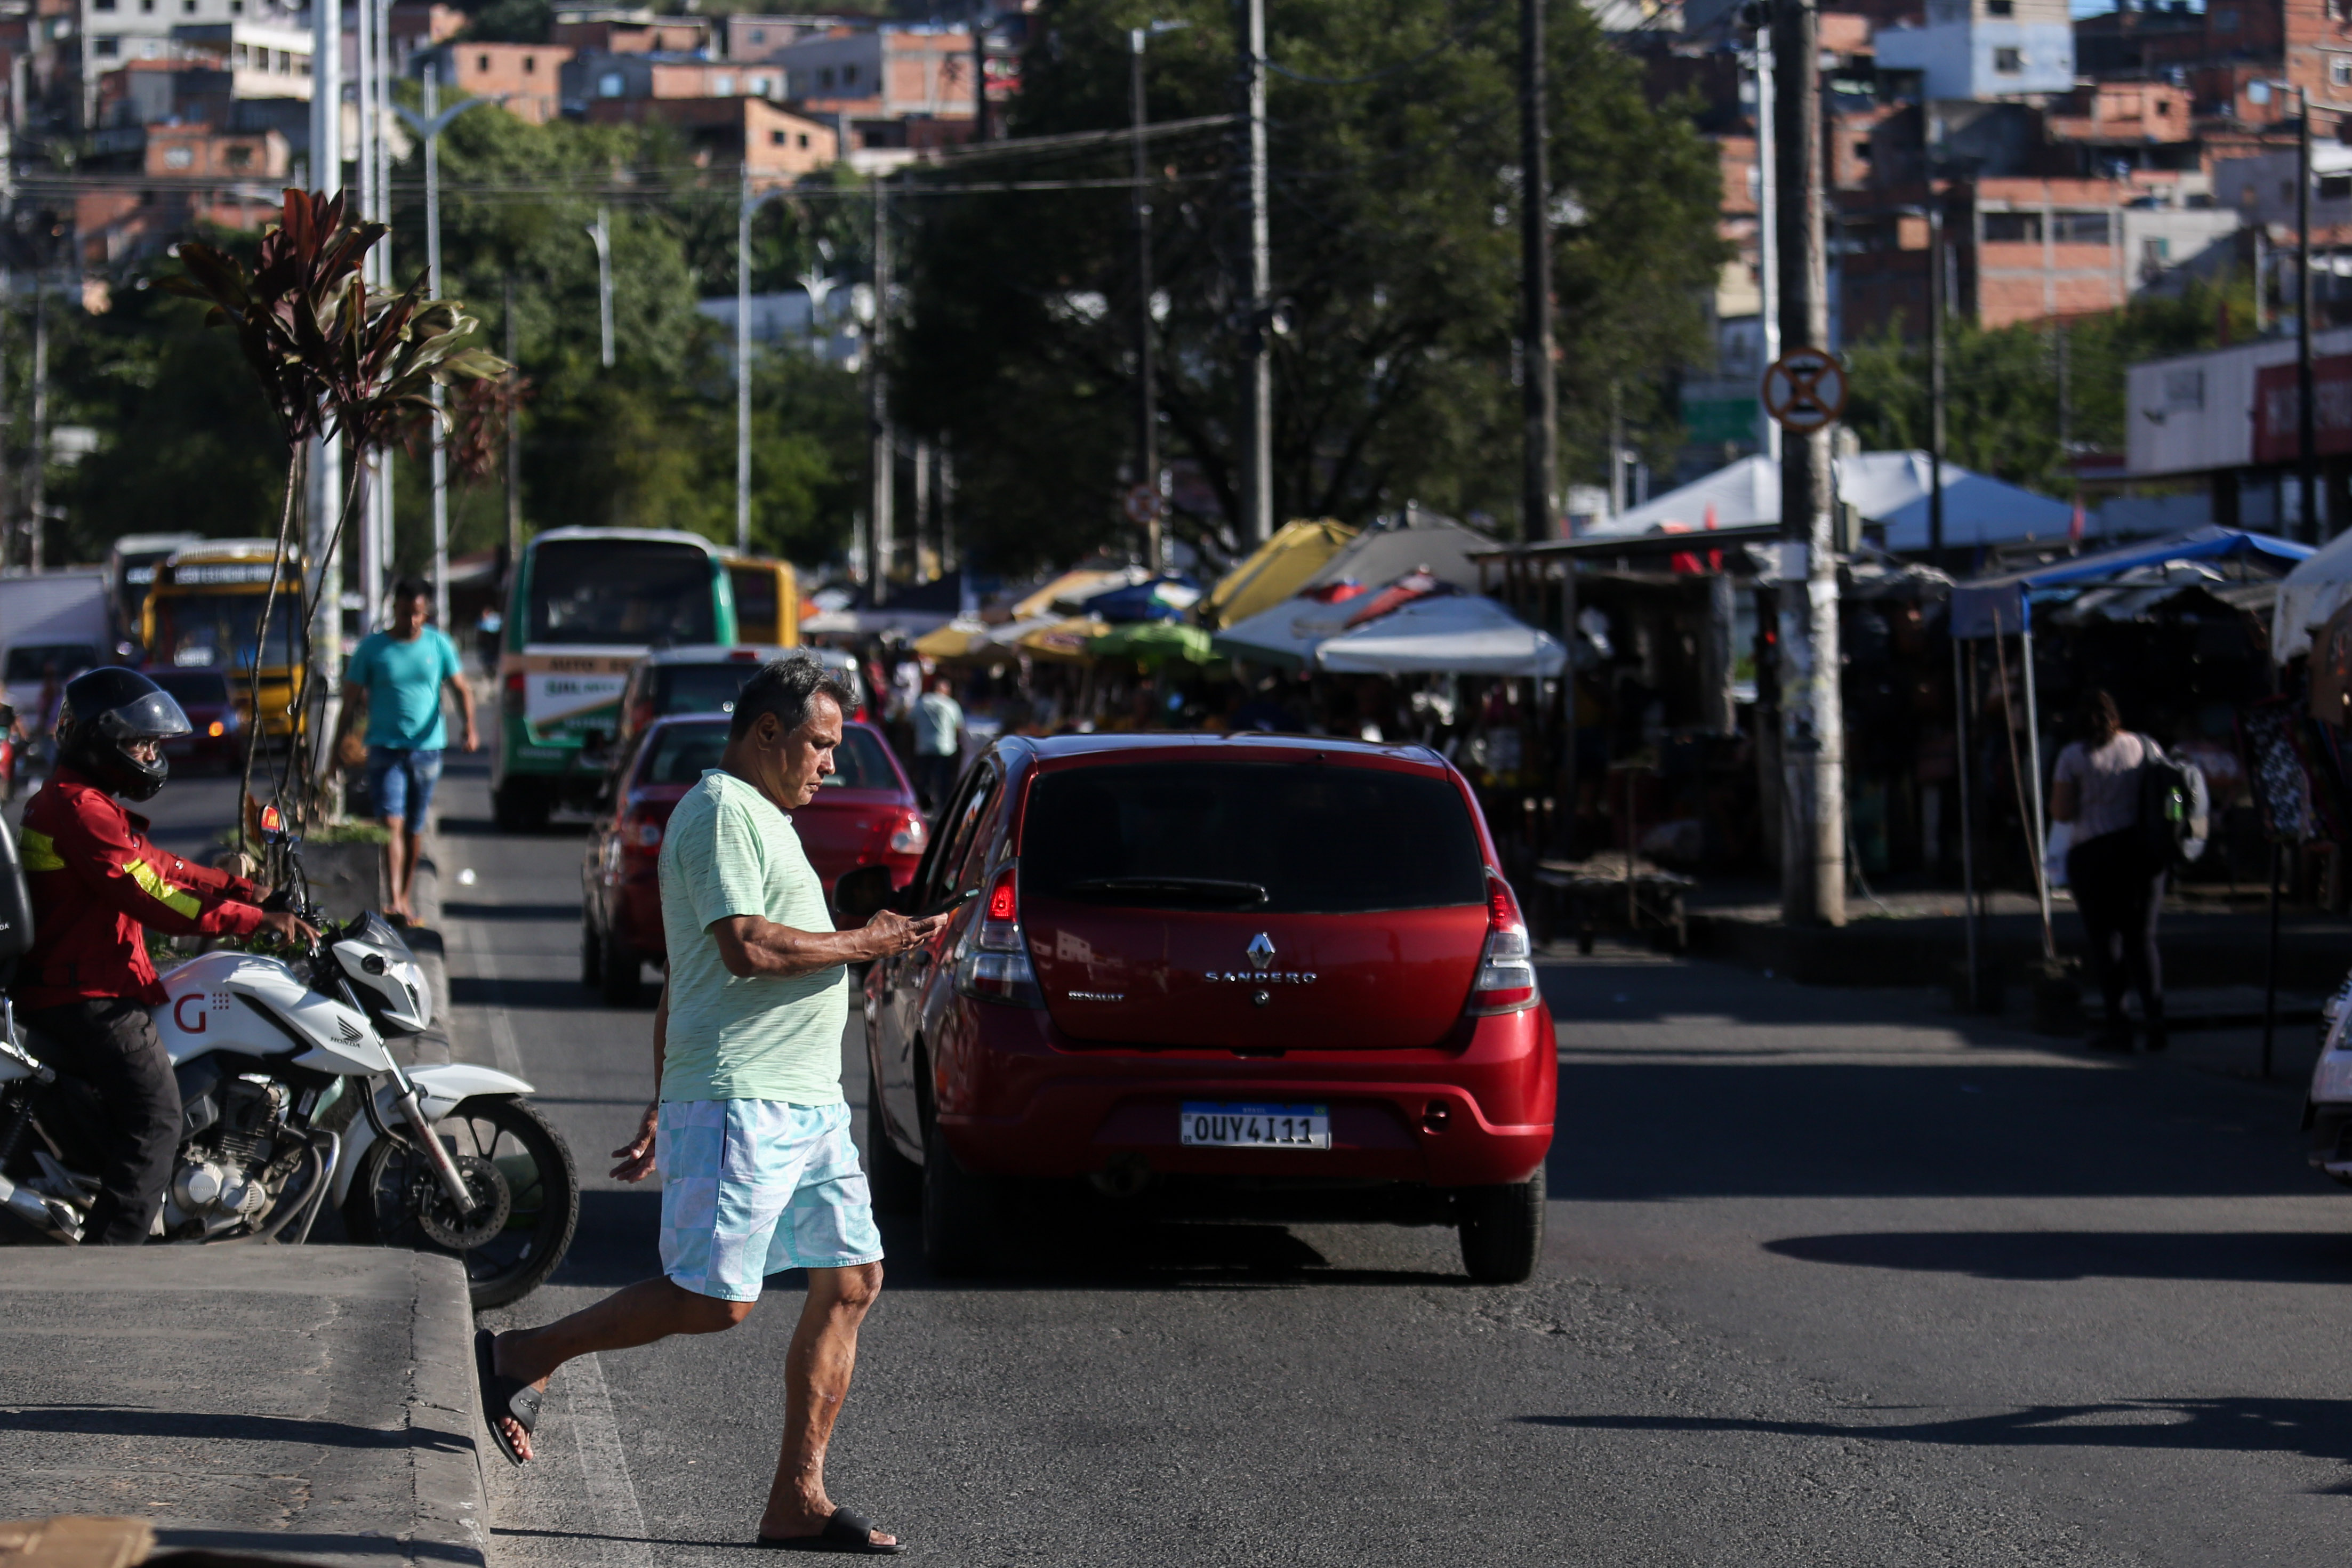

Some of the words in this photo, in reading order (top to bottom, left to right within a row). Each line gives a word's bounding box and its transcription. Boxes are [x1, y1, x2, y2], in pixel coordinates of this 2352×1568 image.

[1205, 971, 1317, 984] SANDERO
[1069, 991, 1124, 1002] RENAULT
[173, 993, 206, 1035] G
[331, 1036, 360, 1049] HONDA
[1194, 1115, 1313, 1144] OUY4I11
